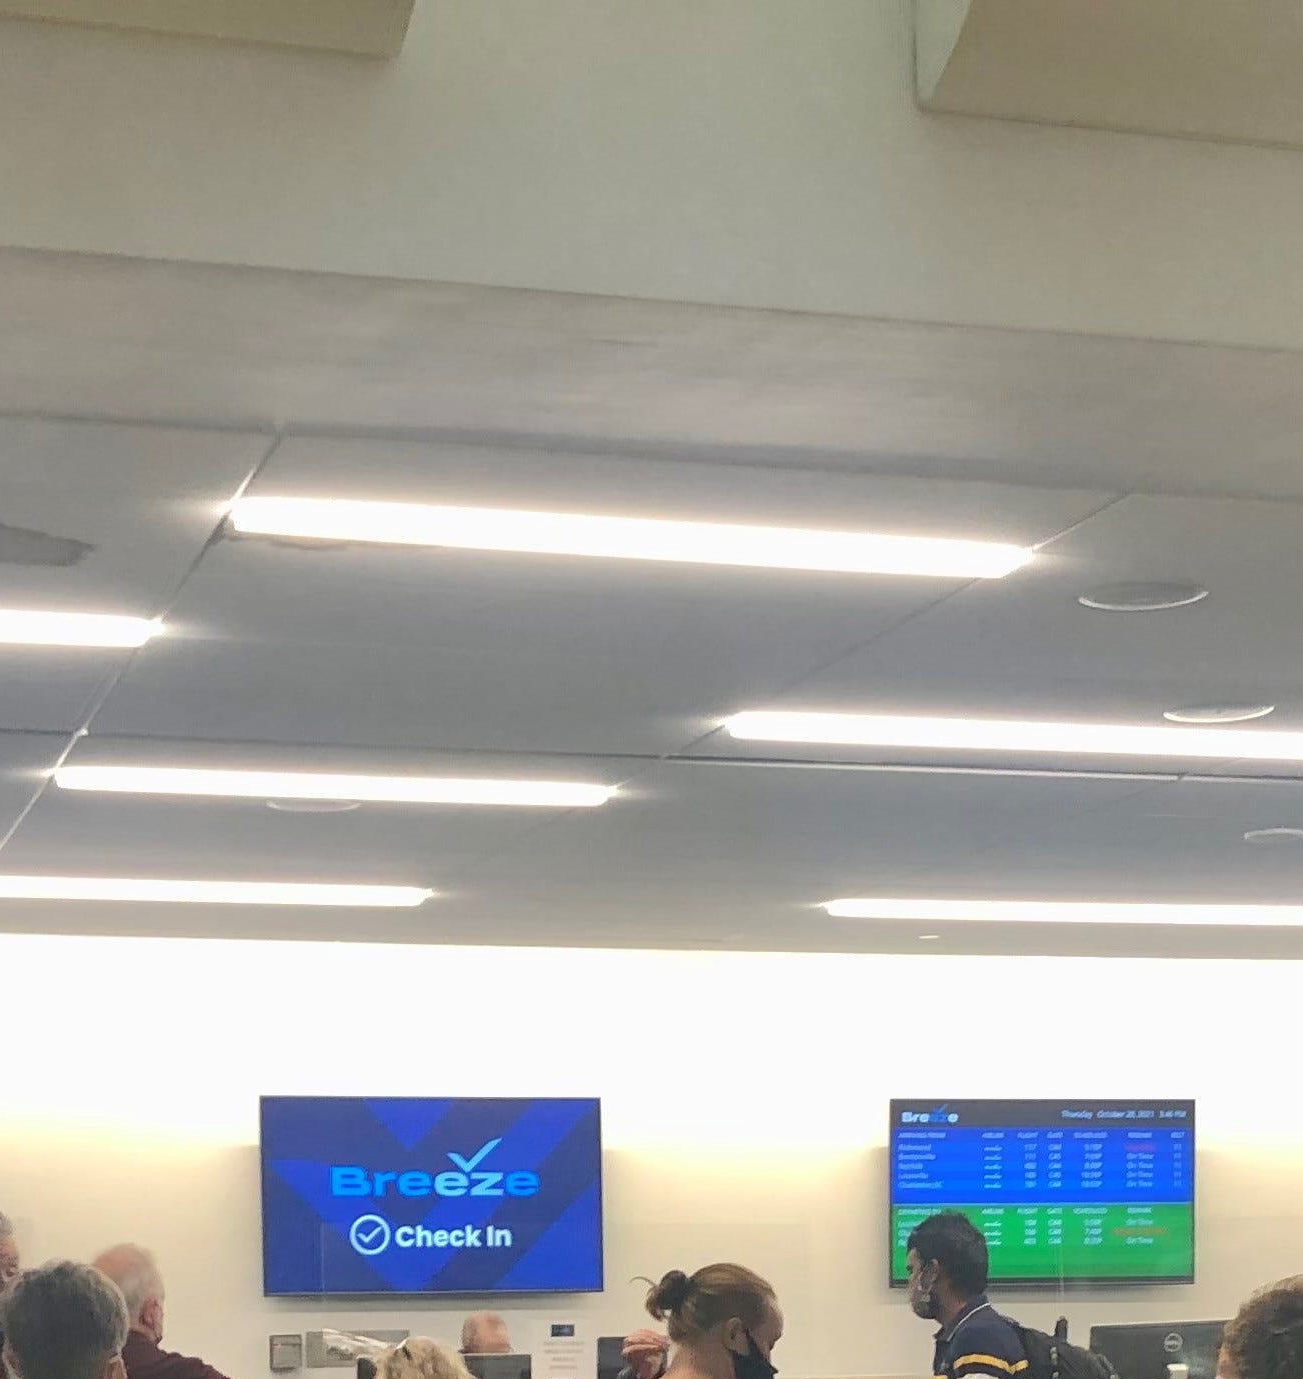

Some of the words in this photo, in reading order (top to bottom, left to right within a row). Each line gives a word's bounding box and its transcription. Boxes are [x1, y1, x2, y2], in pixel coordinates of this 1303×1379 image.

[331, 1166, 539, 1198] Breeze
[394, 1224, 482, 1249] Check
[486, 1225, 513, 1248] In
